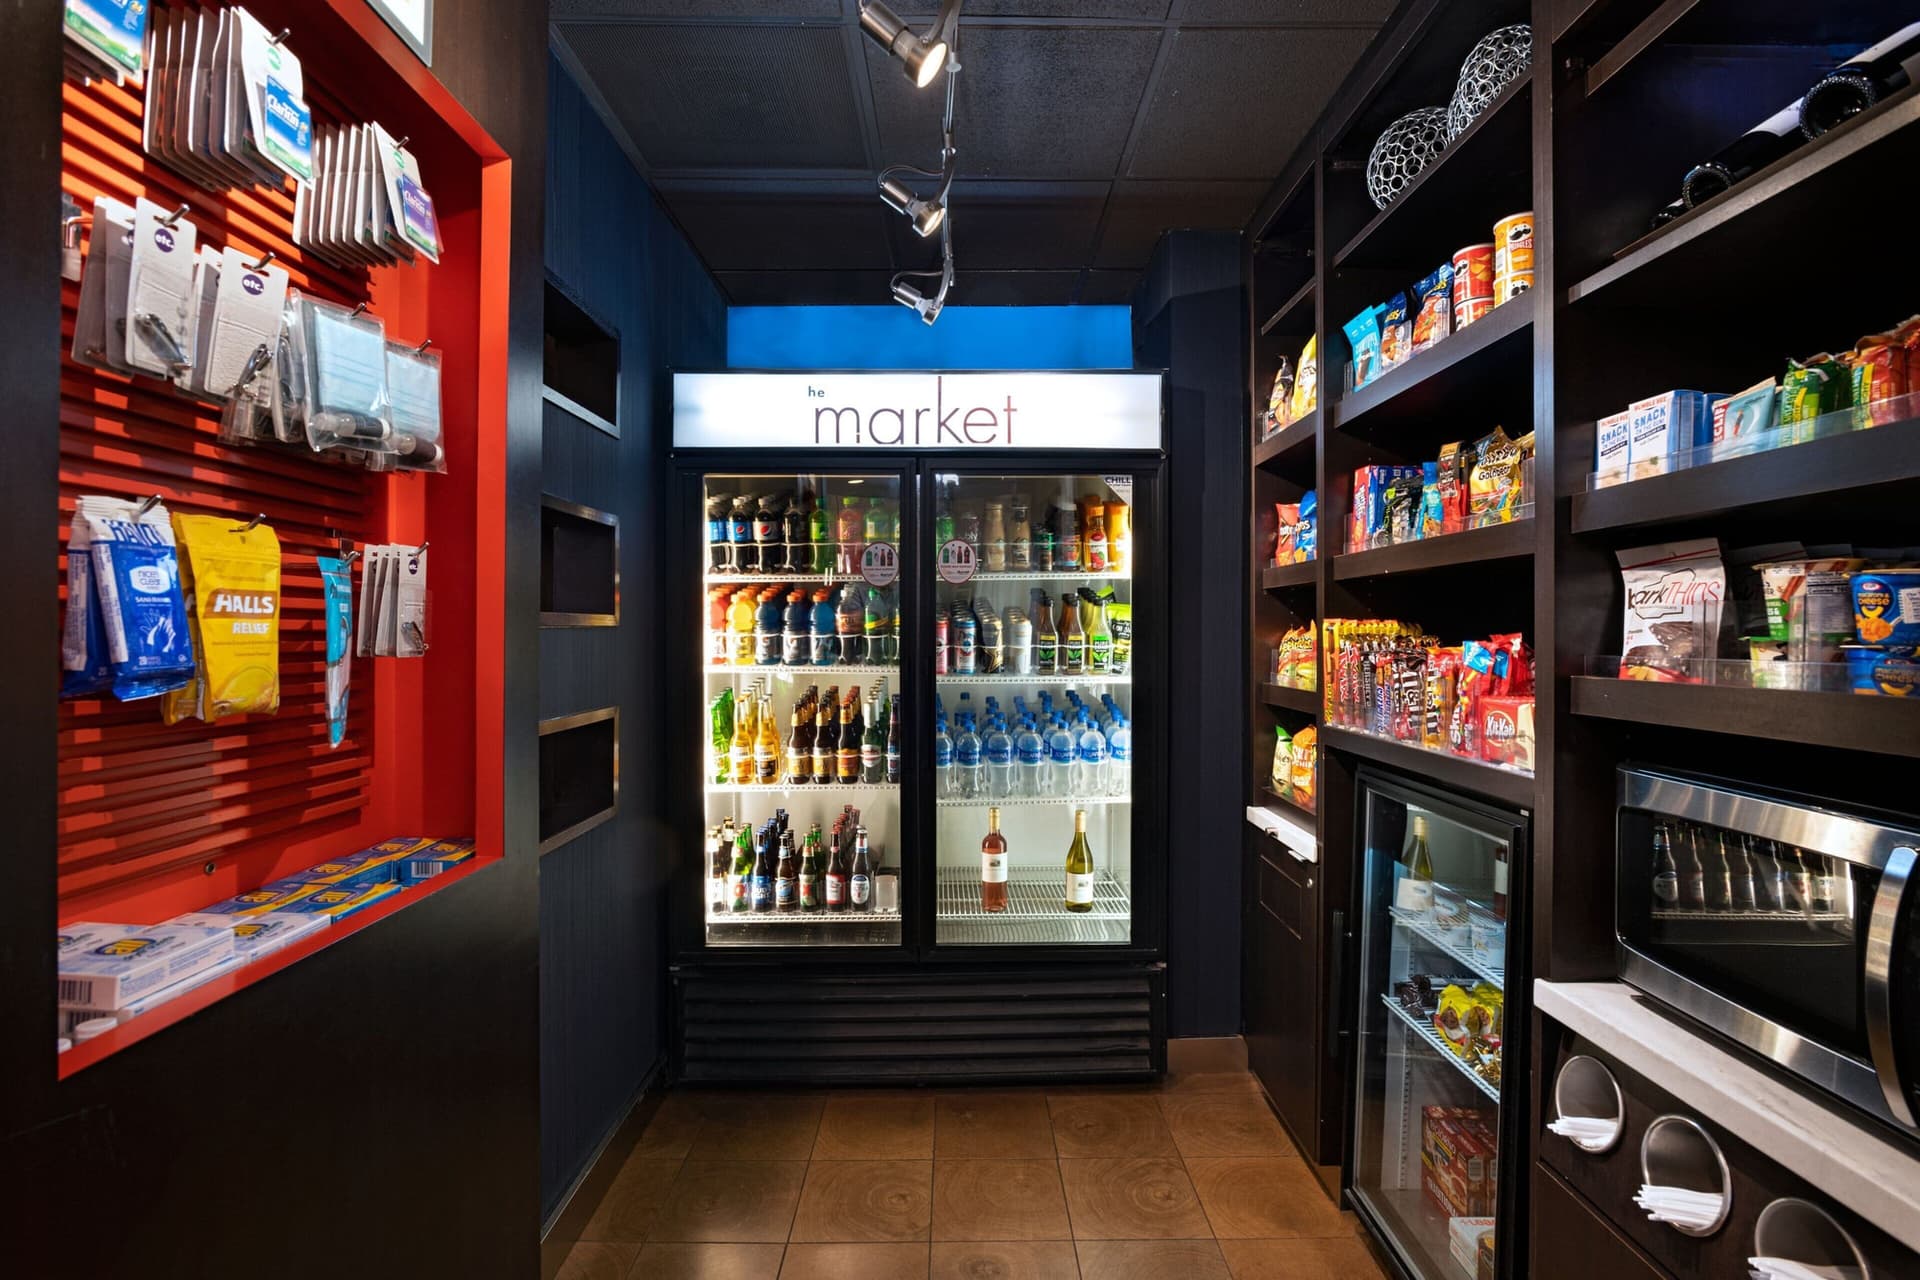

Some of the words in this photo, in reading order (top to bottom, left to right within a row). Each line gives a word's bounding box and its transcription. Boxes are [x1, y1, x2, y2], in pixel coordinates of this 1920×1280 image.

[808, 386, 825, 398] he
[814, 375, 1018, 445] market
[1634, 404, 1667, 430] SNACK
[1600, 422, 1628, 445] SNACK
[1104, 476, 1132, 484] CHILL
[214, 594, 274, 614] HALLS
[232, 622, 270, 635] RELIEF
